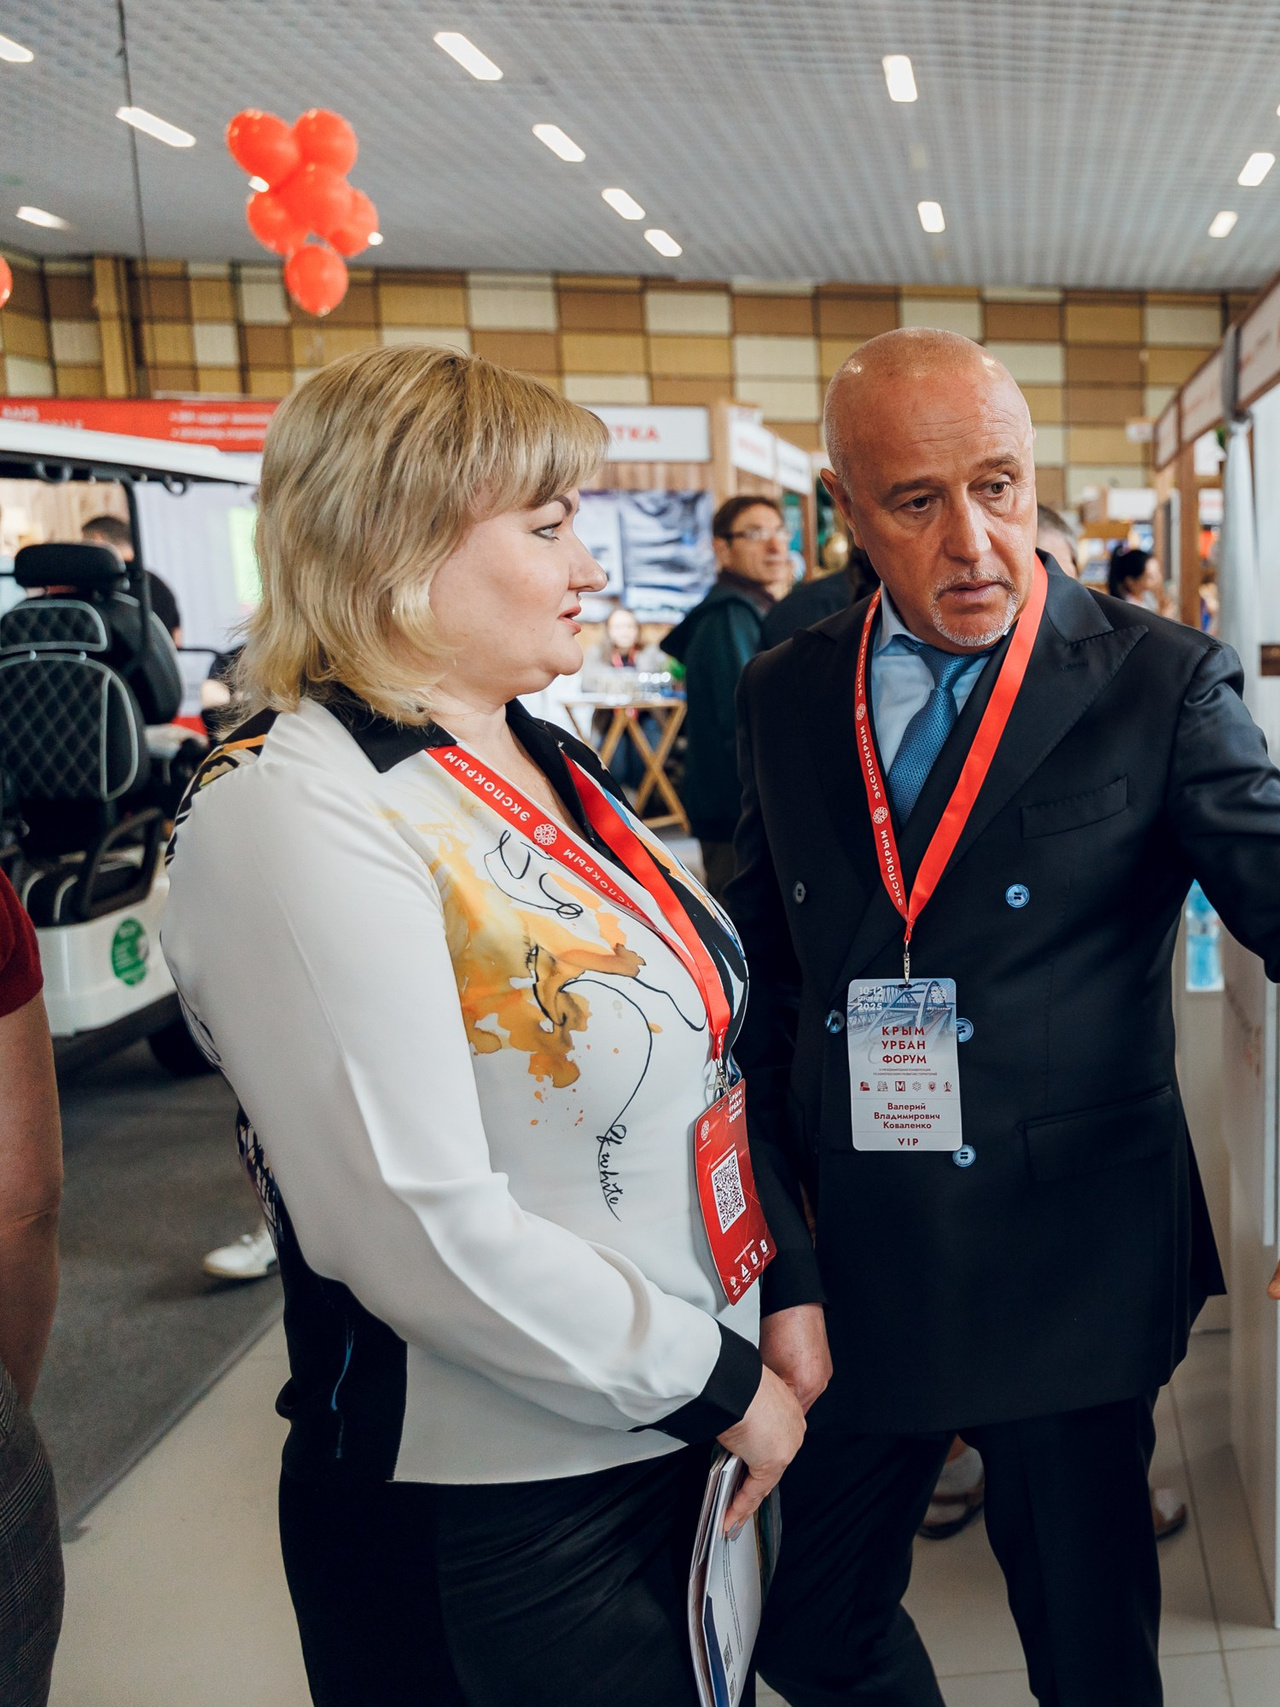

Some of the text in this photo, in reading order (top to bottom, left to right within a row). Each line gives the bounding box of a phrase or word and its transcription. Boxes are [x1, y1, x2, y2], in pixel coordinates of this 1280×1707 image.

[860, 725, 881, 799] ЭКСПОКРЫМ
[444, 752, 531, 822] ЭКСПОКРЫМ
[880, 829, 903, 906] ЭКСПОКРЫМ
[882, 1026, 925, 1036] КРЫМ
[882, 1040, 926, 1050] УРБАН
[882, 1054, 927, 1064] ФОРУМ
[887, 1102, 926, 1112] Валерий
[874, 1112, 940, 1121] Владимирович
[883, 1121, 932, 1129] Коваленко
[897, 1138, 919, 1147] VIP
